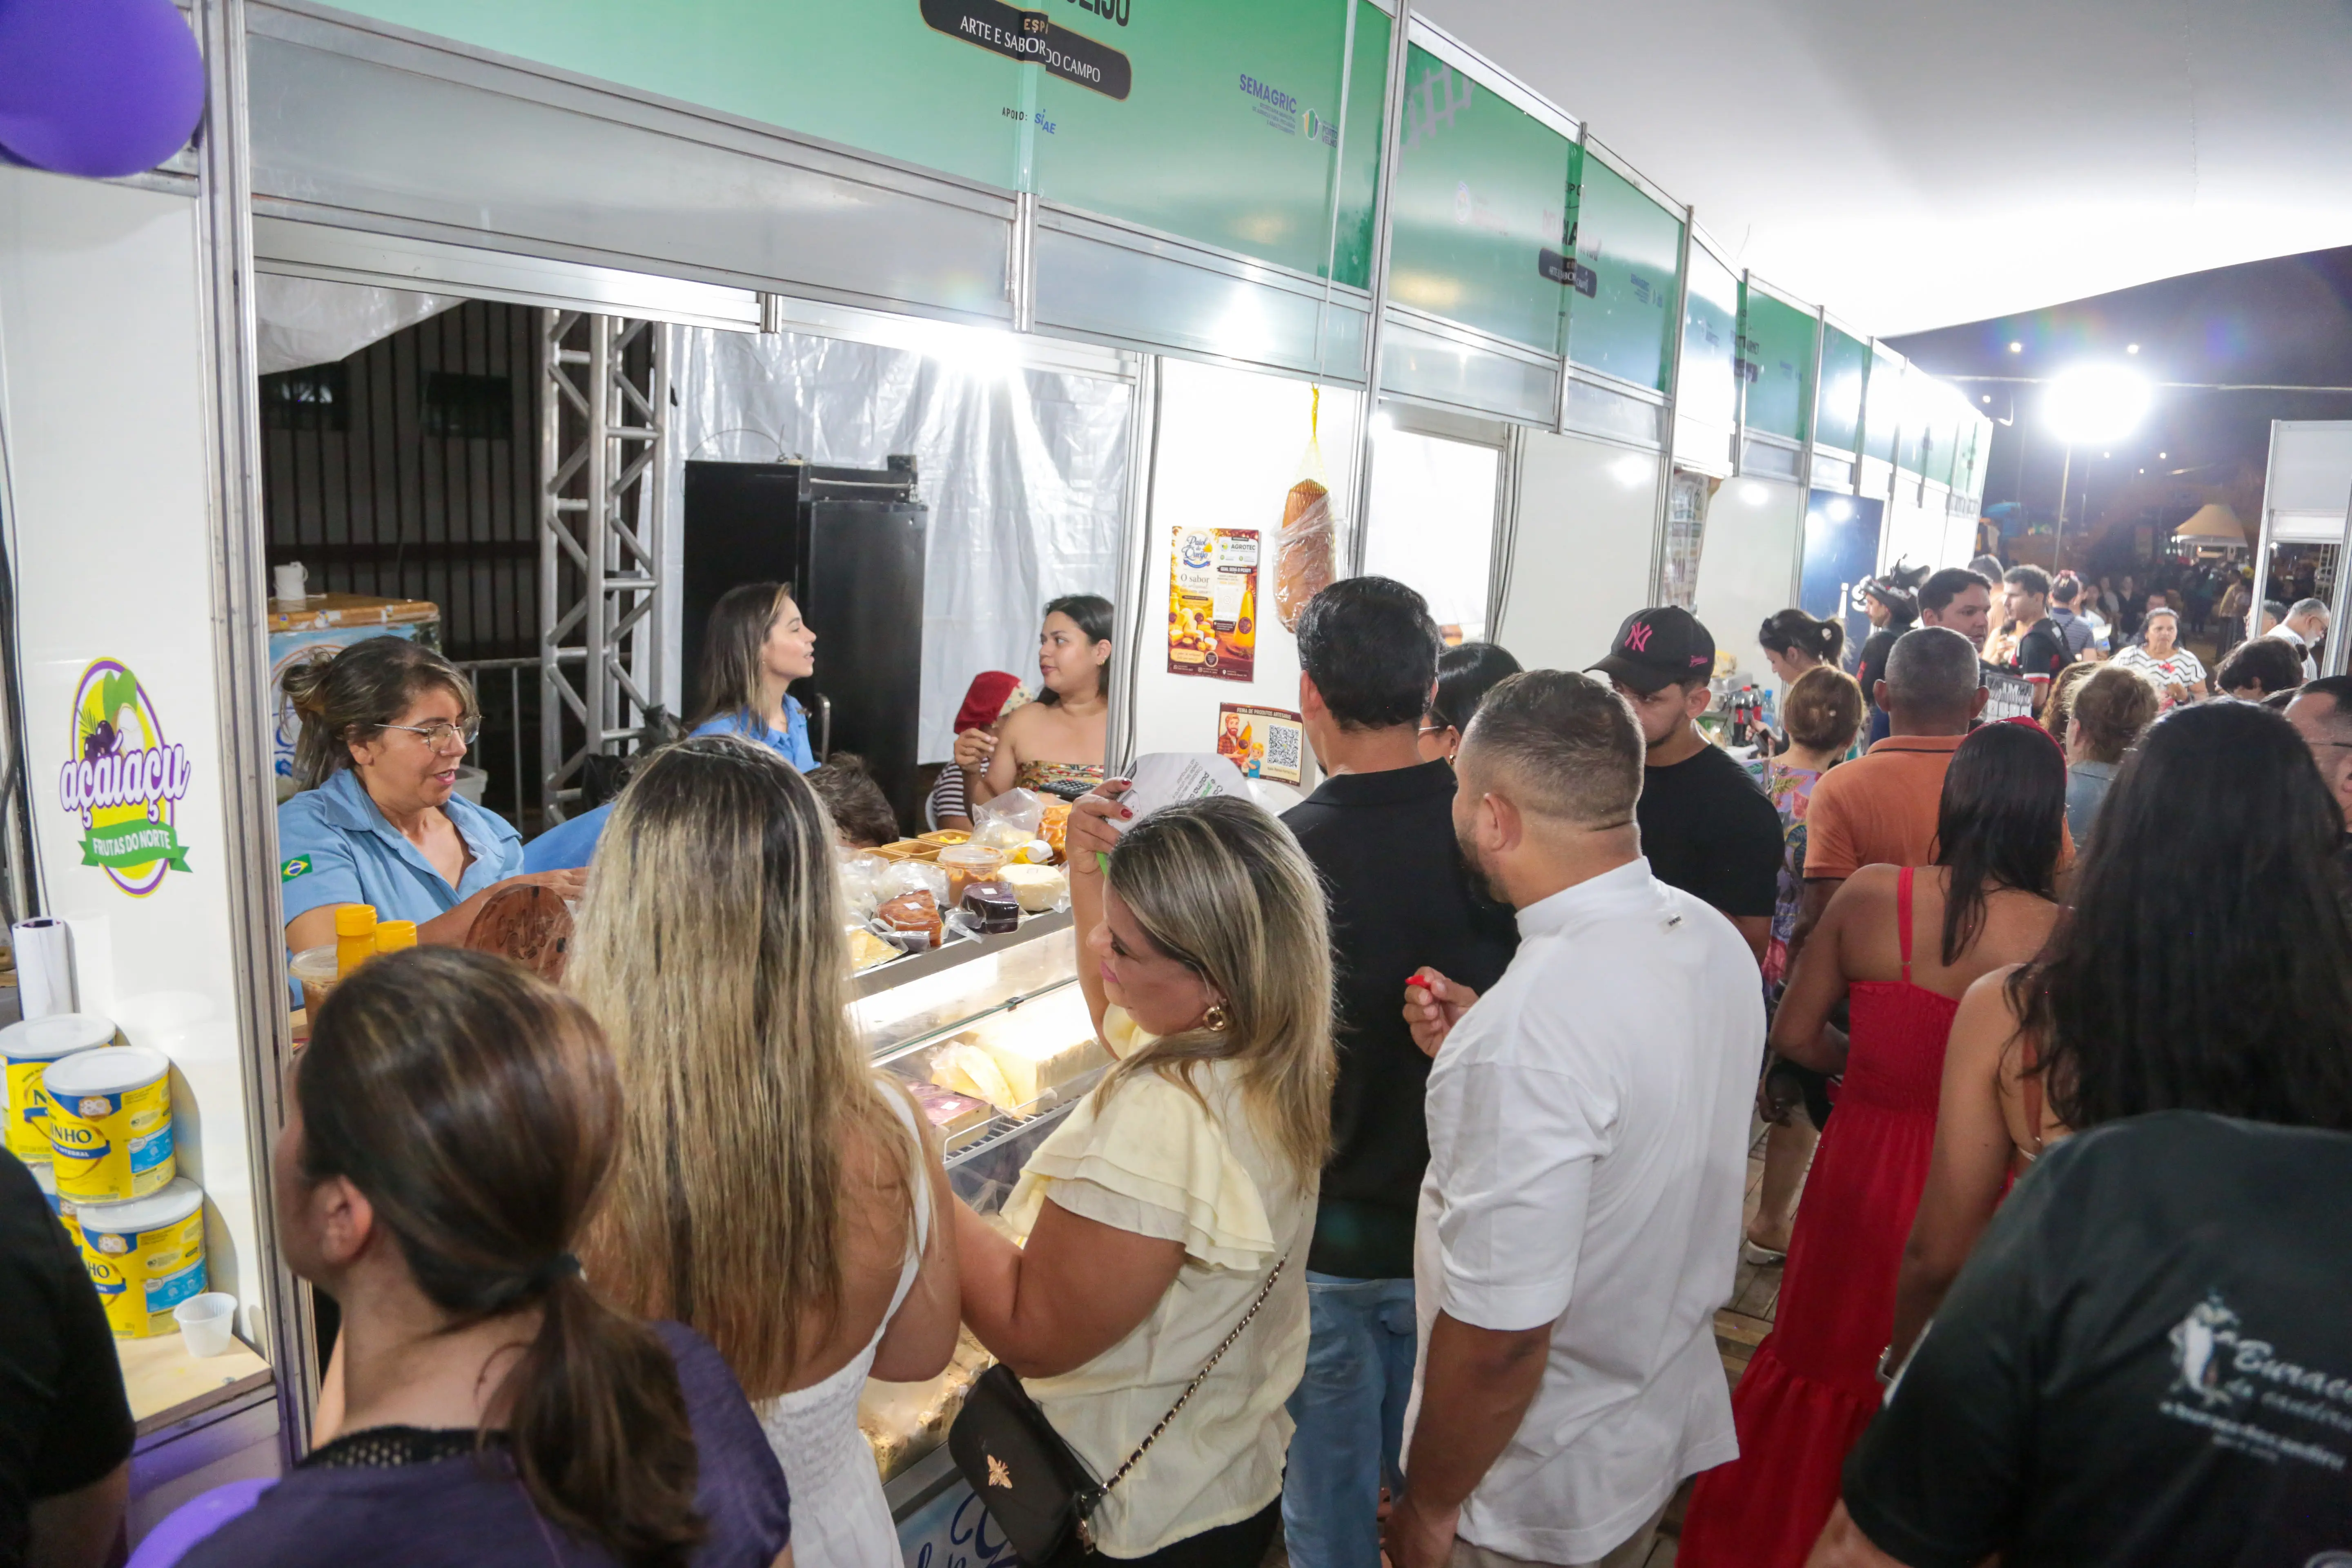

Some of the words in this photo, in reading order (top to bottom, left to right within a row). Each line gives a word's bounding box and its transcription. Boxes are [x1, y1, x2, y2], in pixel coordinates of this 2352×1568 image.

[960, 16, 991, 40] ARTE
[995, 29, 1002, 44] E
[1004, 32, 1046, 56] SABOR
[1063, 56, 1100, 82] CAMPO
[1240, 74, 1296, 114] SEMAGRIC
[1187, 536, 1208, 546] Paiol
[1181, 546, 1208, 561] Queijo
[1181, 573, 1187, 581] O
[1189, 575, 1210, 583] sabor
[1193, 771, 1209, 794] palma
[93, 836, 125, 857] FRUTAS
[125, 833, 140, 851] DO
[139, 829, 171, 850] NORTE
[50, 1122, 92, 1143] INHO
